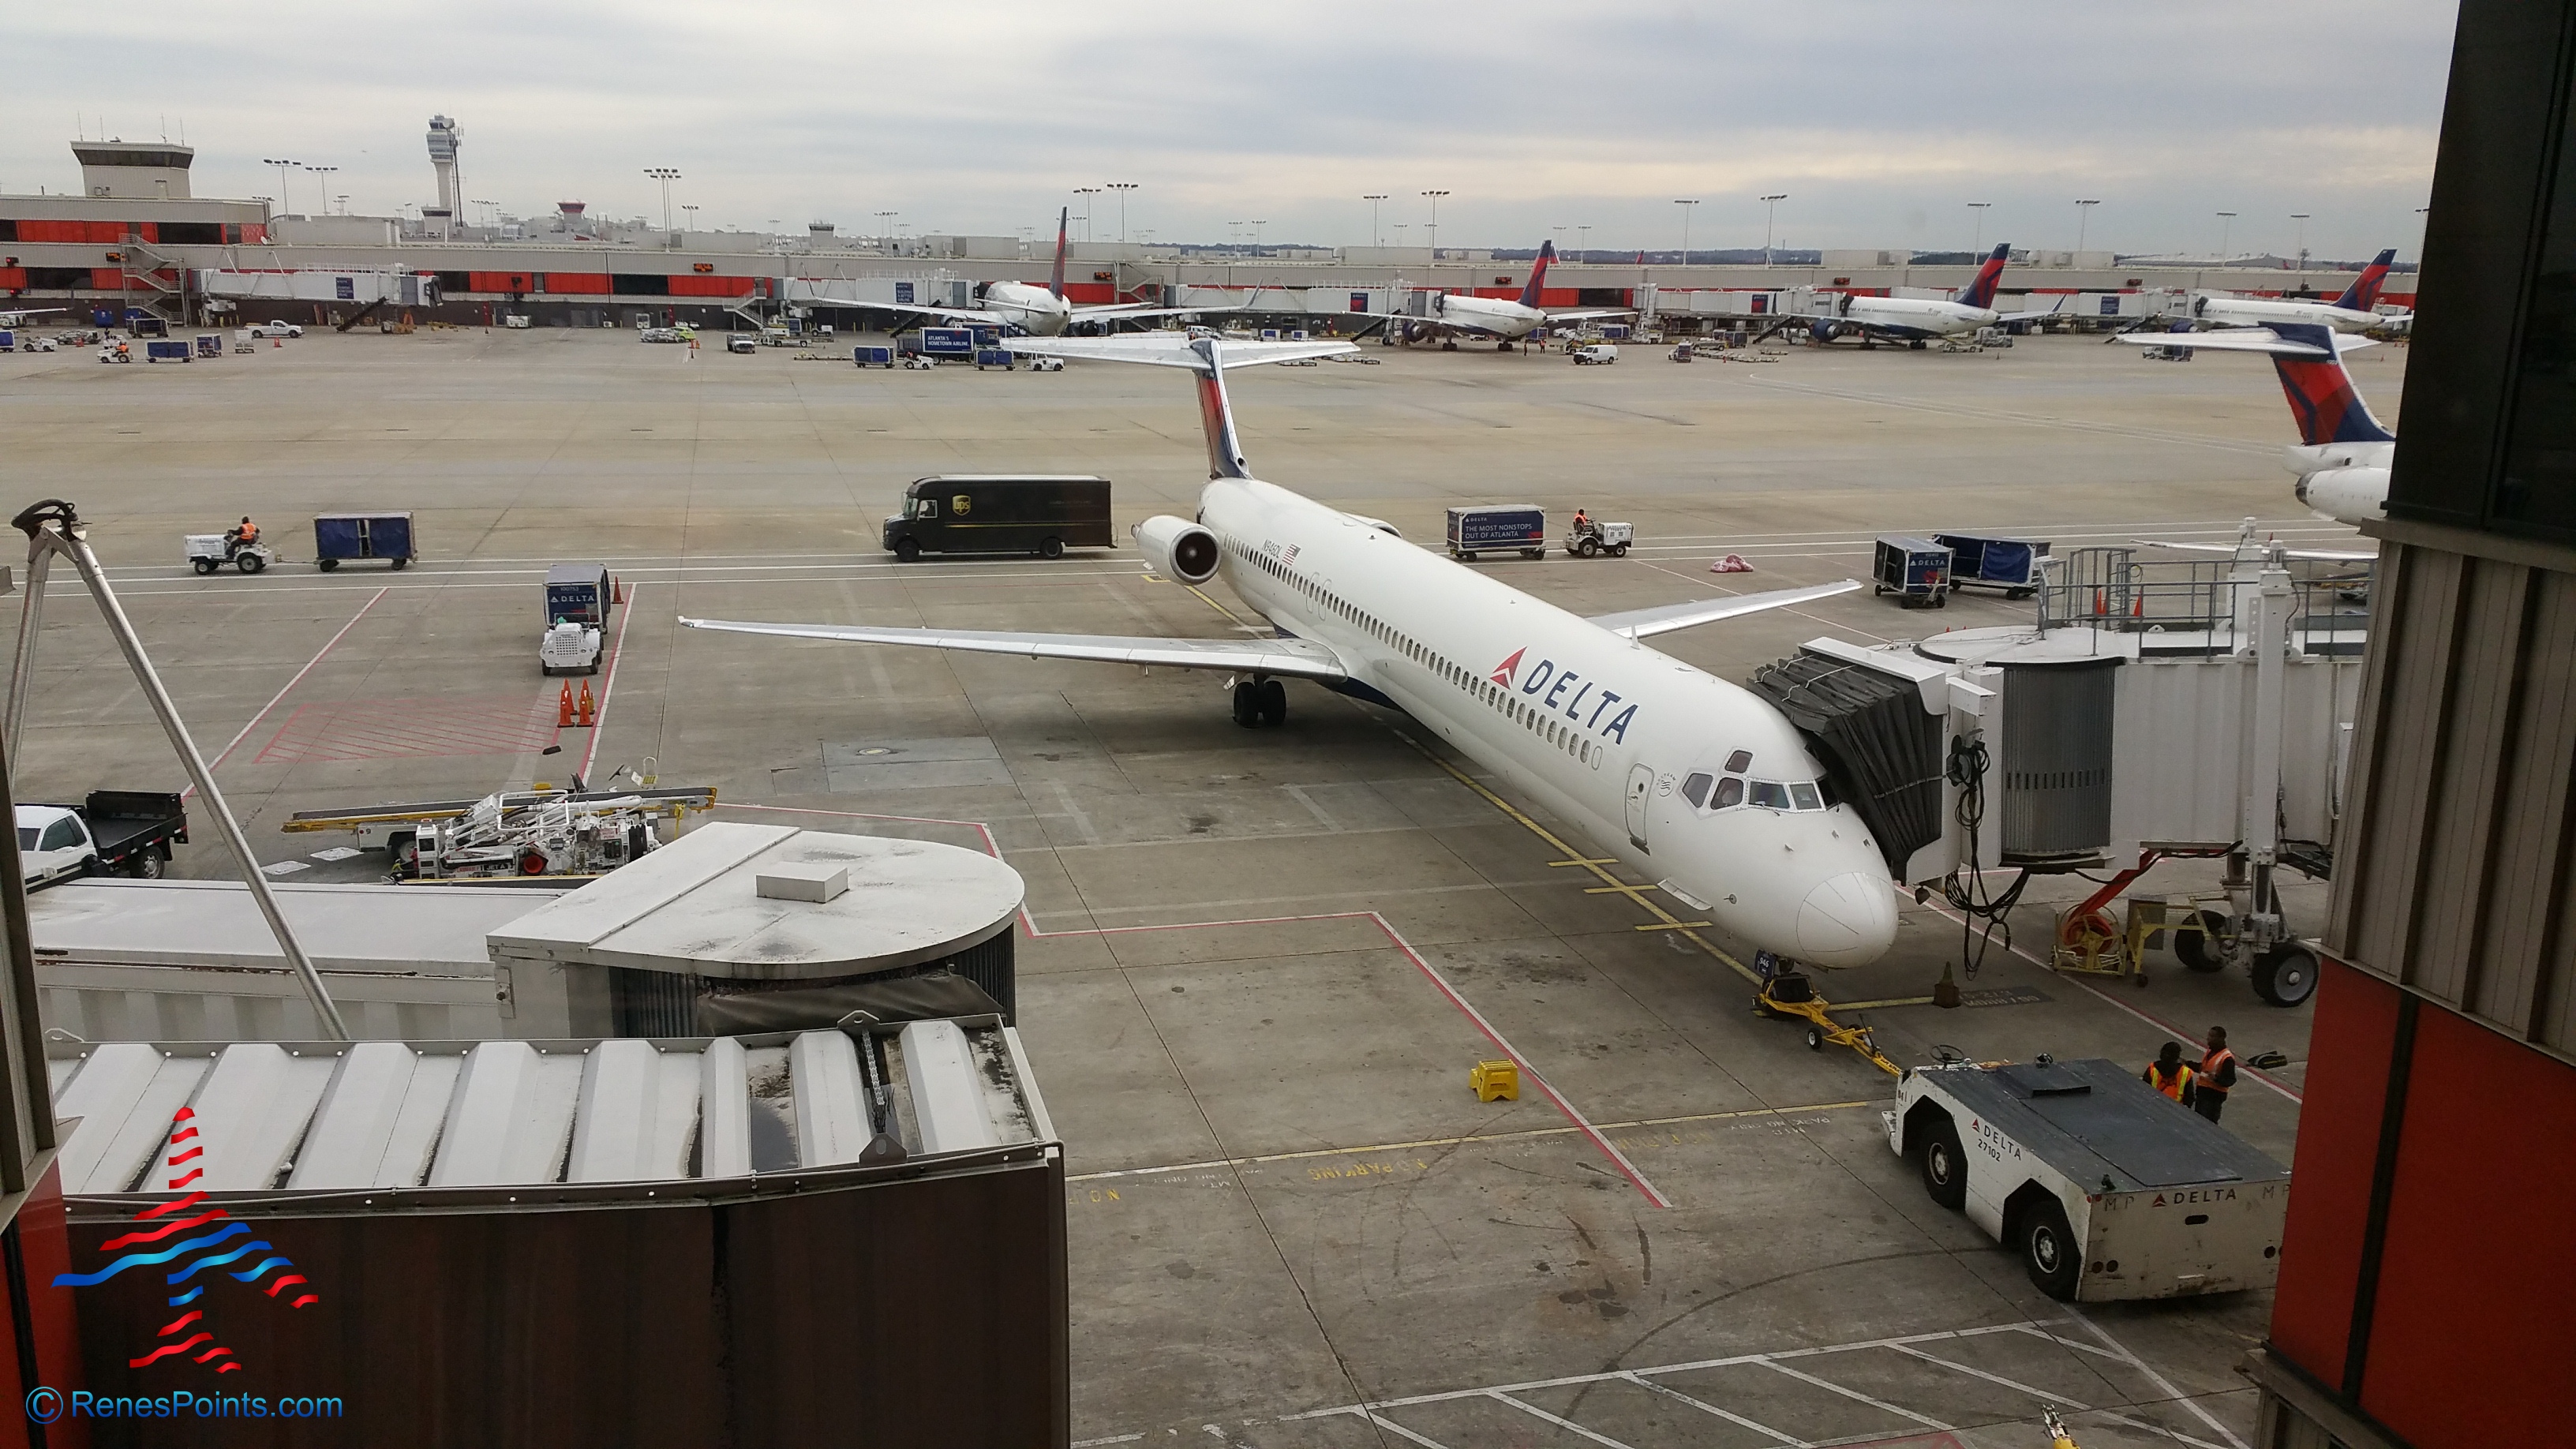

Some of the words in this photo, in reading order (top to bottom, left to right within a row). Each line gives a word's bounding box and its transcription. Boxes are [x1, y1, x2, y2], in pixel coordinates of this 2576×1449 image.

[954, 500, 970, 511] ups
[1522, 659, 1639, 745] DELTA
[1977, 1138, 2001, 1163] 27102
[1983, 1124, 2022, 1161] DELTA
[1091, 1189, 1121, 1202] NO
[2174, 1189, 2237, 1205] DELTA
